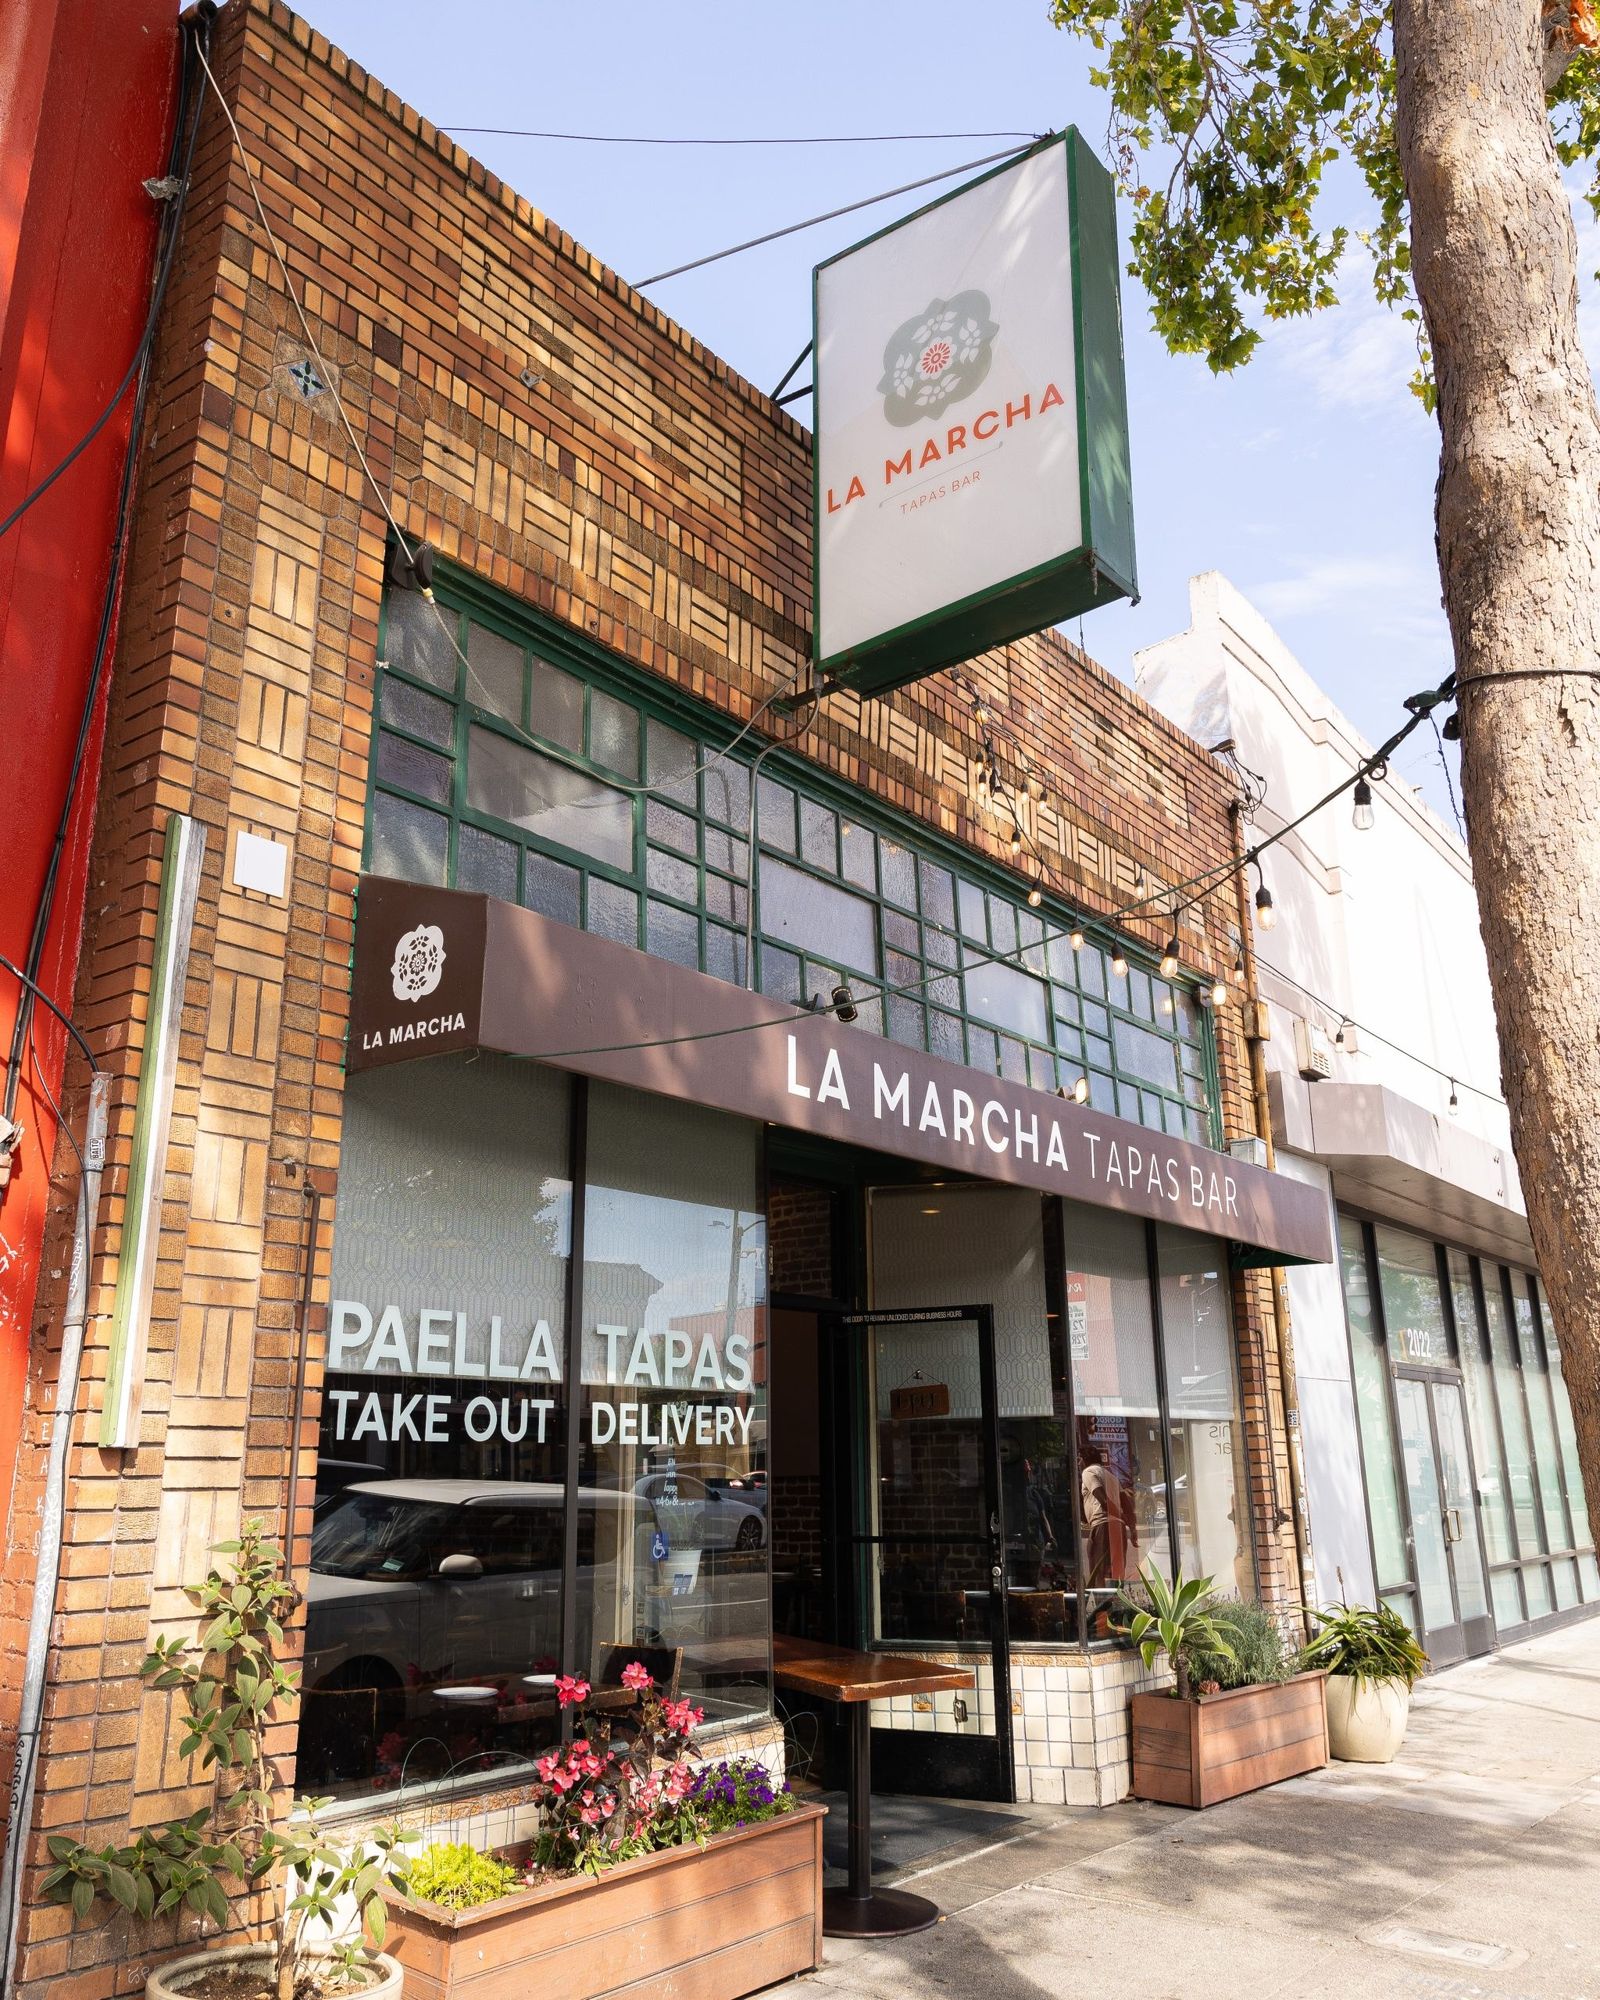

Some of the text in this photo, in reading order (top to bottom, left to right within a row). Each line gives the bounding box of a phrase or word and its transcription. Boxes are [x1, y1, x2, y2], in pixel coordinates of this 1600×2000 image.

[826, 382, 1066, 515] LA MARCHA
[900, 469, 981, 515] TAPAS BAR
[362, 1012, 466, 1051] LA MARCHA
[787, 1034, 1239, 1218] LA MARCHA TAPAS BAR
[327, 1300, 753, 1391] PAELLA TAPAS
[1407, 1328, 1432, 1358] 2022
[329, 1390, 755, 1446] TAKE OUT DELIVERY
